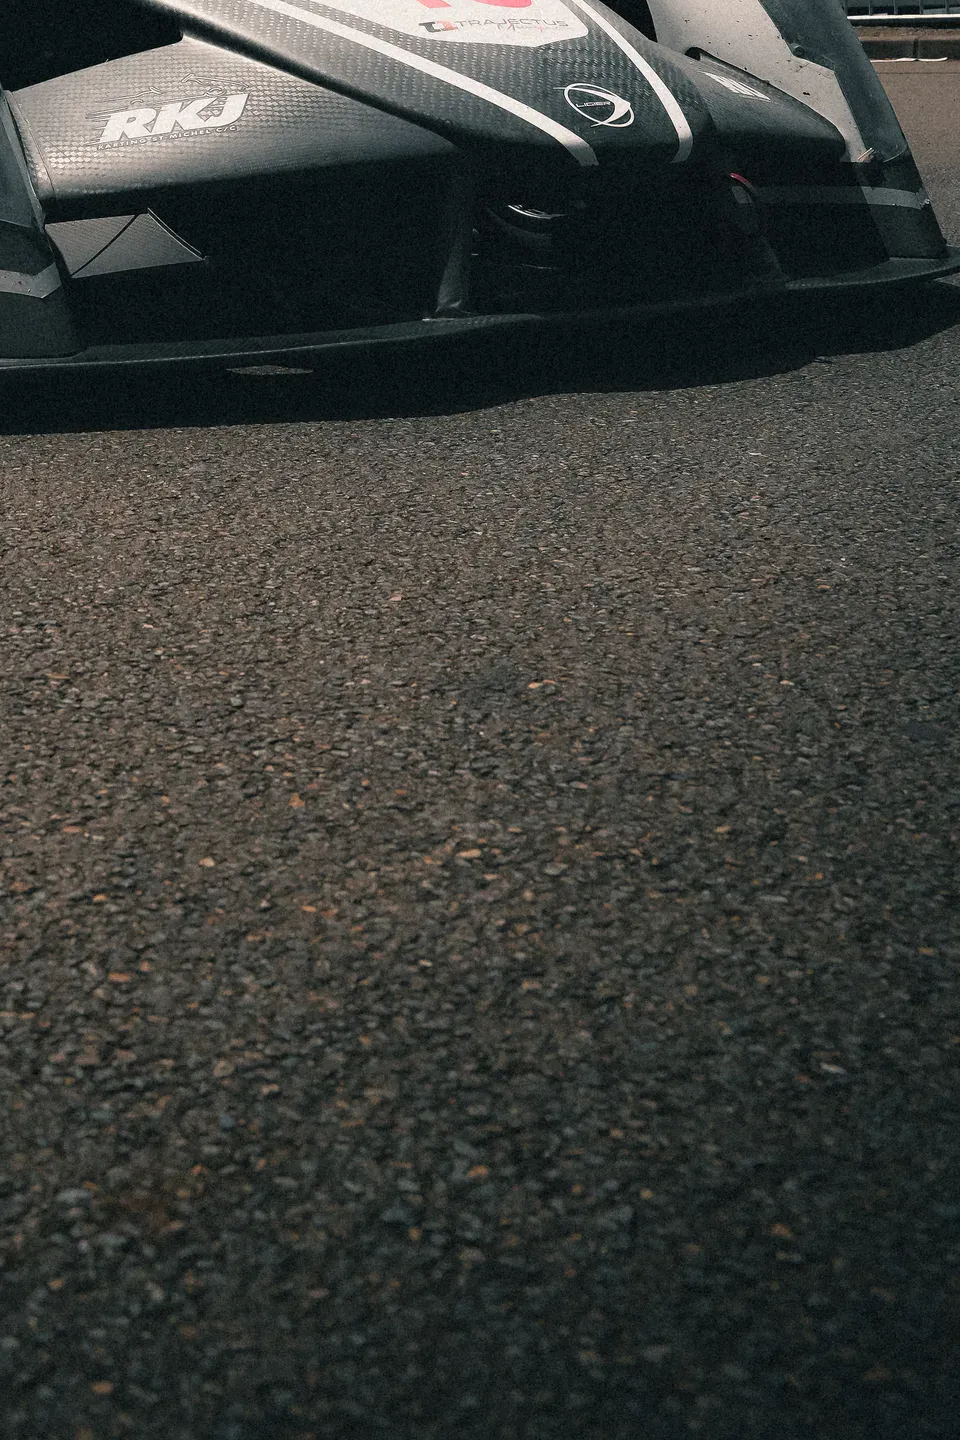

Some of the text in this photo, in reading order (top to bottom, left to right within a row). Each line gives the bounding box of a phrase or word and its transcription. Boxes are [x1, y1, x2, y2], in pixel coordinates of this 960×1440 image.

[95, 93, 250, 144] RKJ
[96, 138, 148, 151] KARTING
[216, 125, 238, 134] C/C
